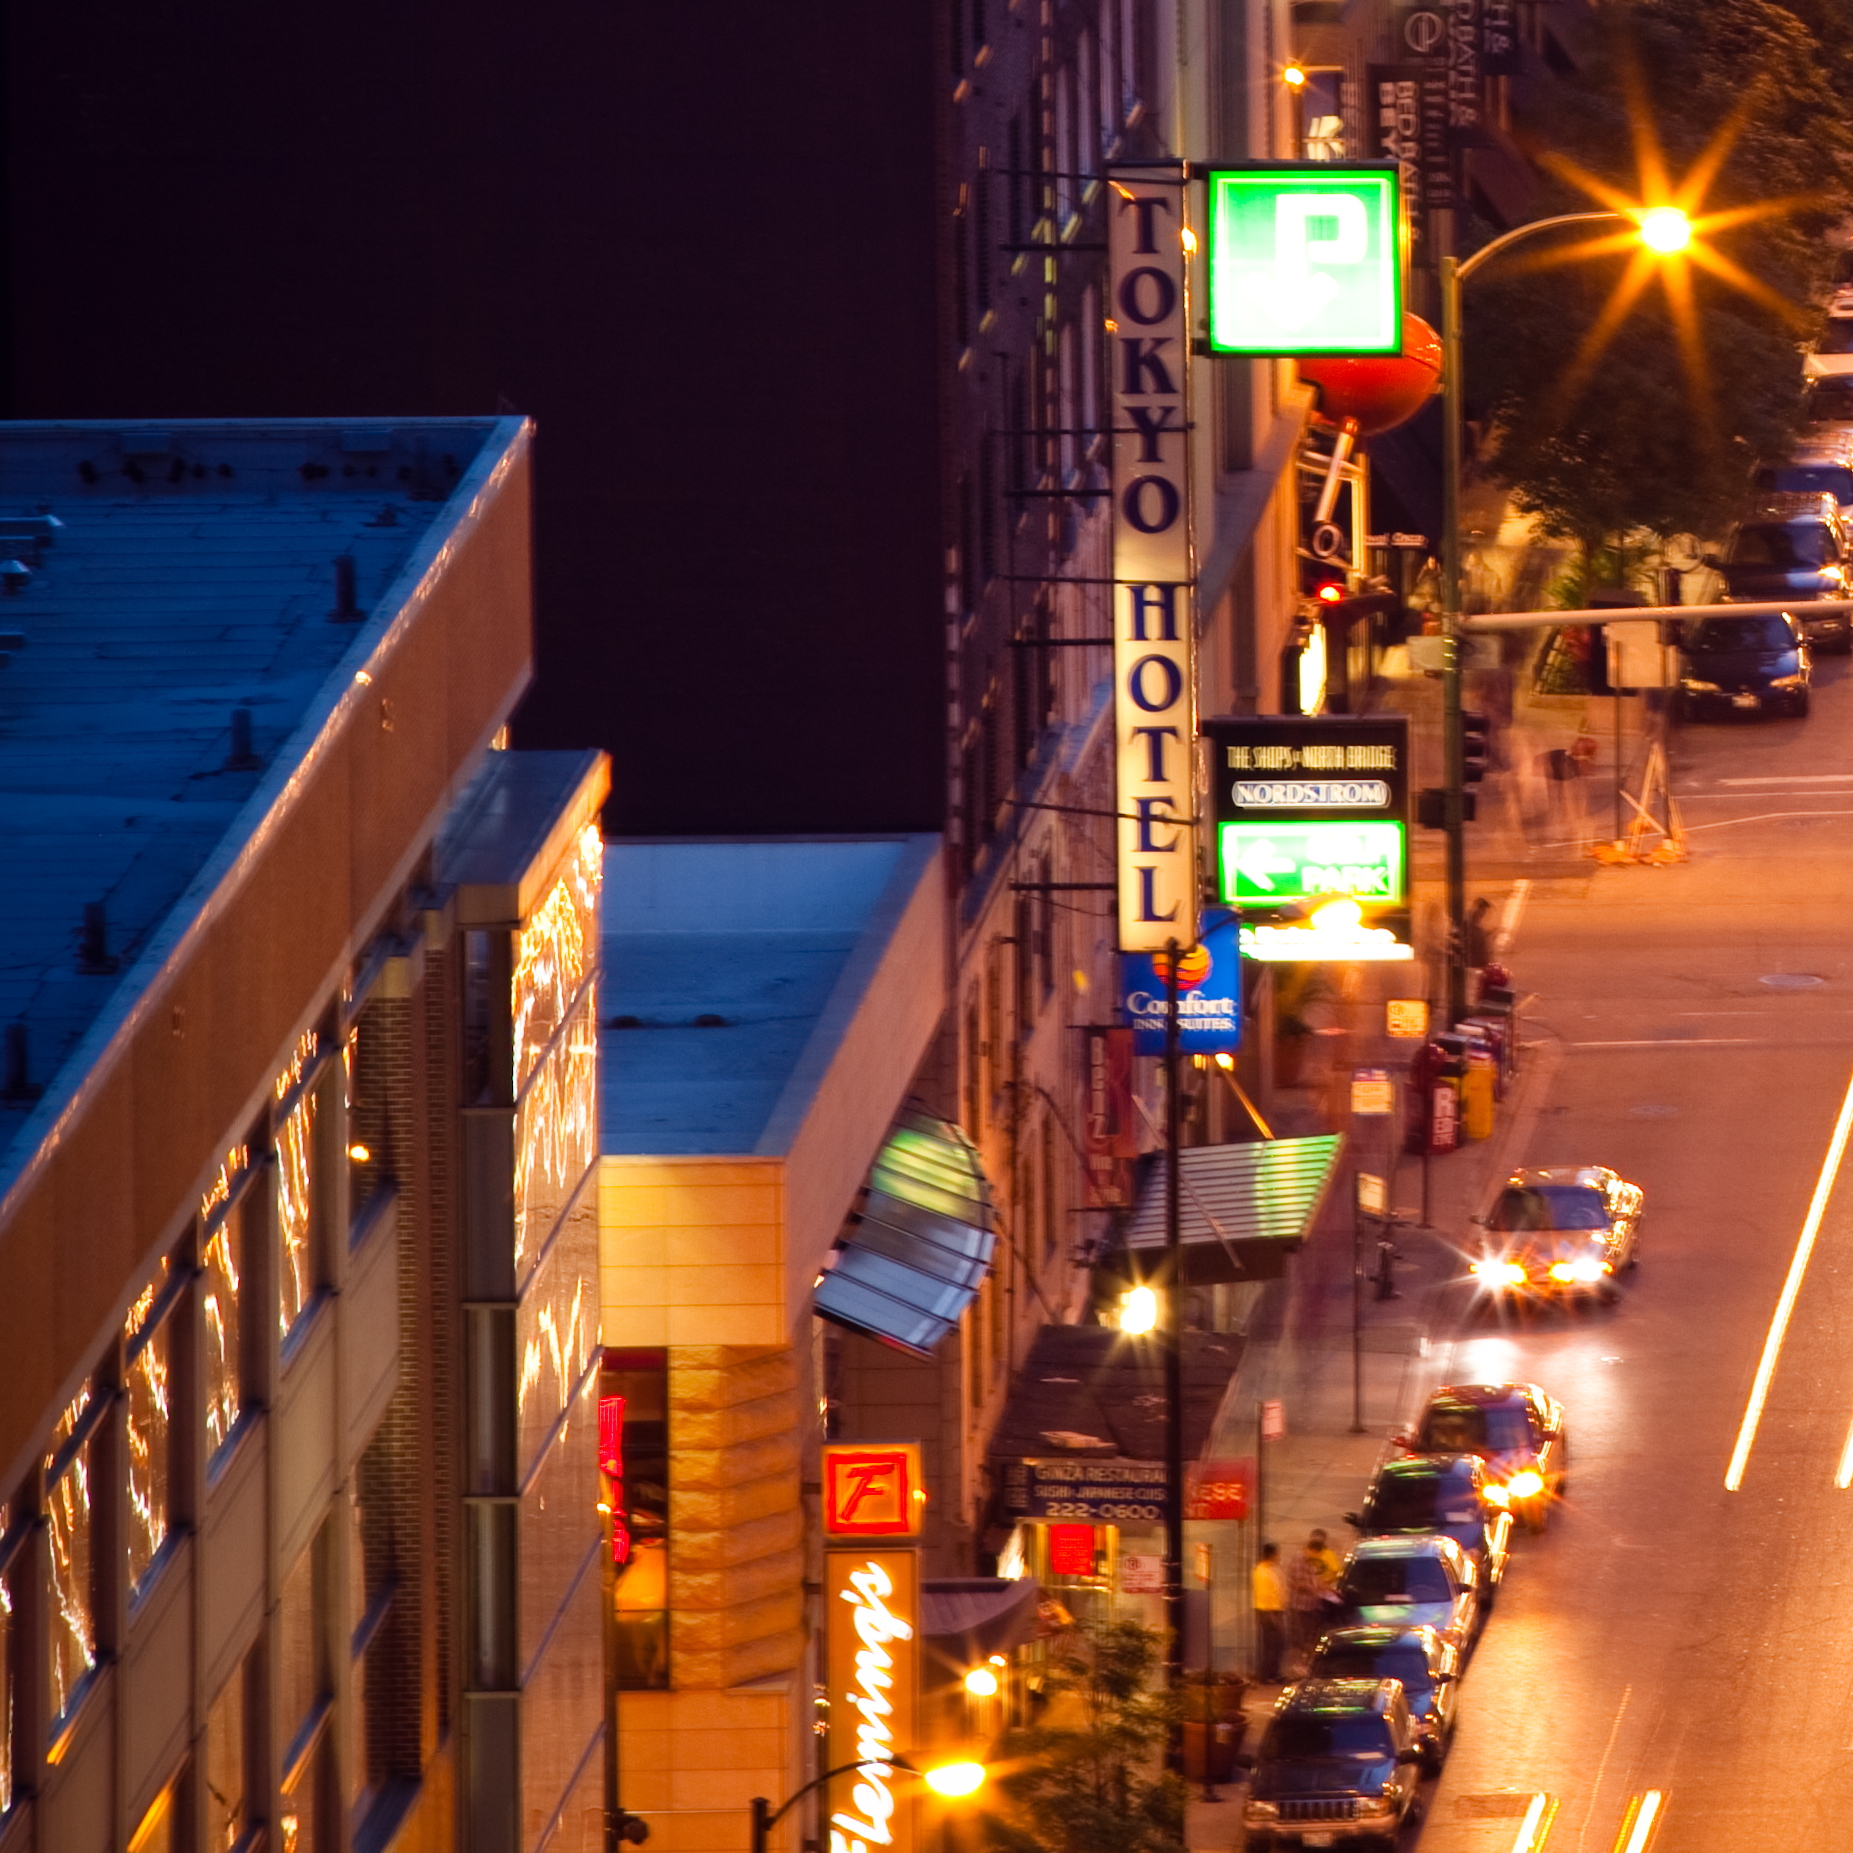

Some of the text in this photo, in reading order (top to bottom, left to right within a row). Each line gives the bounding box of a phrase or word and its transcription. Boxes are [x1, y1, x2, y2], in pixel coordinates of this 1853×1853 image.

[1457, 26, 1477, 100] BATH
[1397, 81, 1418, 137] BED
[1400, 142, 1421, 218] BATH
[1117, 197, 1181, 535] TOKYO
[1126, 584, 1183, 923] HOTEL
[1227, 746, 1251, 769] THE
[1252, 746, 1293, 769] SHOPS
[1302, 746, 1345, 769] NORTH
[1346, 746, 1398, 770] BRIDGE
[1236, 782, 1384, 804] NORDSTROM
[1302, 866, 1390, 894] PARK
[1176, 1017, 1237, 1032] SUITES
[1034, 1466, 1084, 1482] GINZA
[1034, 1485, 1167, 1502] SUSHI JAPANESE CUIS
[1046, 1502, 1161, 1520] 222-0600
